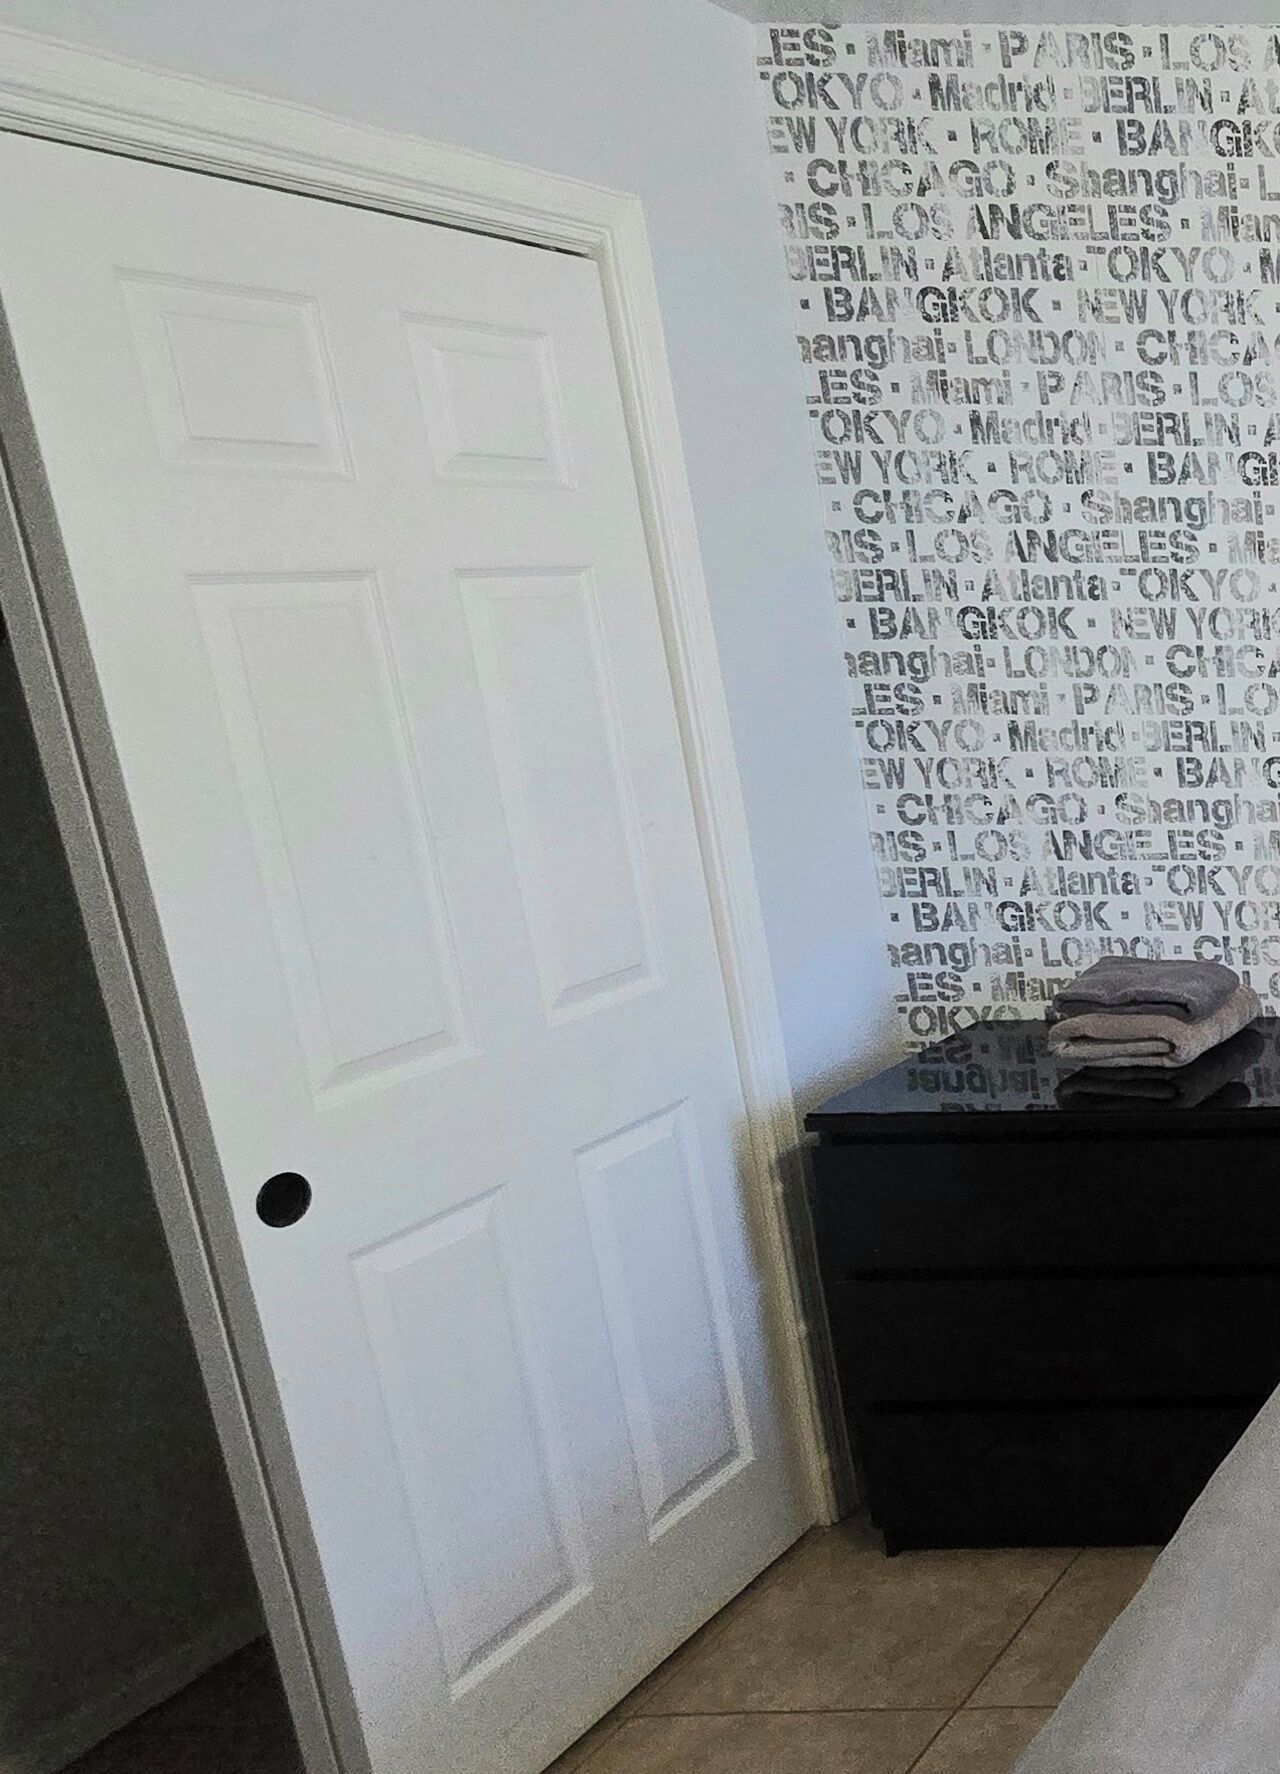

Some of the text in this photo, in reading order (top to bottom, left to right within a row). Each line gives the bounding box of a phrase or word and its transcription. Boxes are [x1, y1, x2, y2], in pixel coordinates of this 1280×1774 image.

[867, 29, 973, 68] Miami
[998, 31, 1136, 70] PARIS
[1159, 33, 1251, 72] LOS
[928, 73, 1056, 112] Madrid
[806, 159, 1016, 198] CHICAGO
[1044, 162, 1238, 208] Shanghai
[824, 286, 1041, 323] BANGKOK
[1074, 288, 1148, 324] NEW
[1157, 288, 1265, 325] YORK
[968, 410, 1091, 445] Madrid
[852, 489, 1052, 524] CHICAGO
[1078, 490, 1264, 532] Shanghai
[906, 529, 993, 564] LOS
[1002, 528, 1200, 564] ANGELES
[869, 606, 1077, 640] BANGKOK
[1007, 719, 1125, 752] Madrid
[897, 792, 1088, 826] CHICAGO
